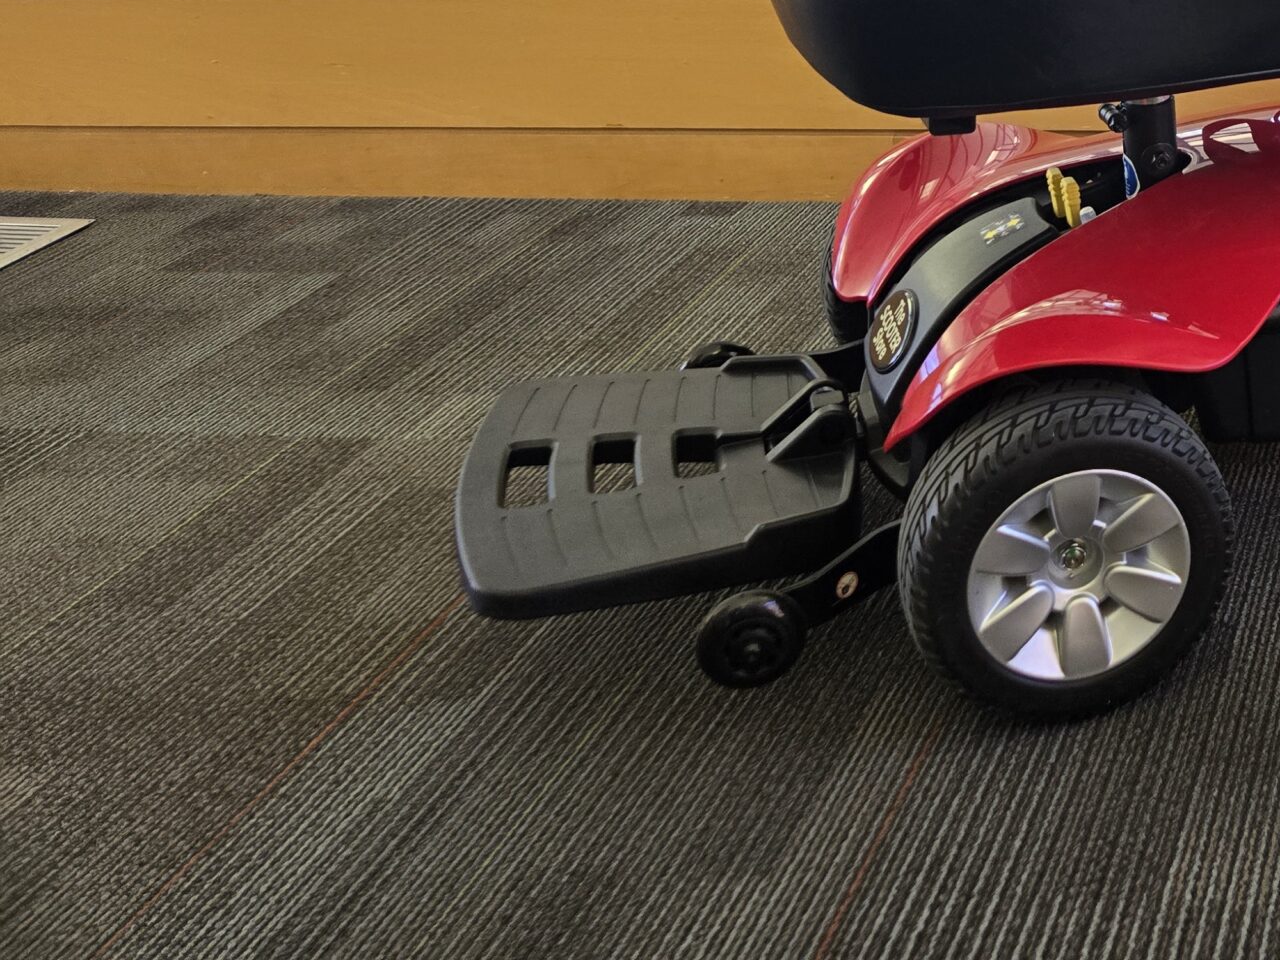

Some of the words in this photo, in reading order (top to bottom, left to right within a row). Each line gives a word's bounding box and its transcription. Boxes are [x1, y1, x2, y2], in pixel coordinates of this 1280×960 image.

[880, 304, 902, 354] SCOOTER
[893, 298, 906, 326] The
[872, 327, 887, 361] Store
